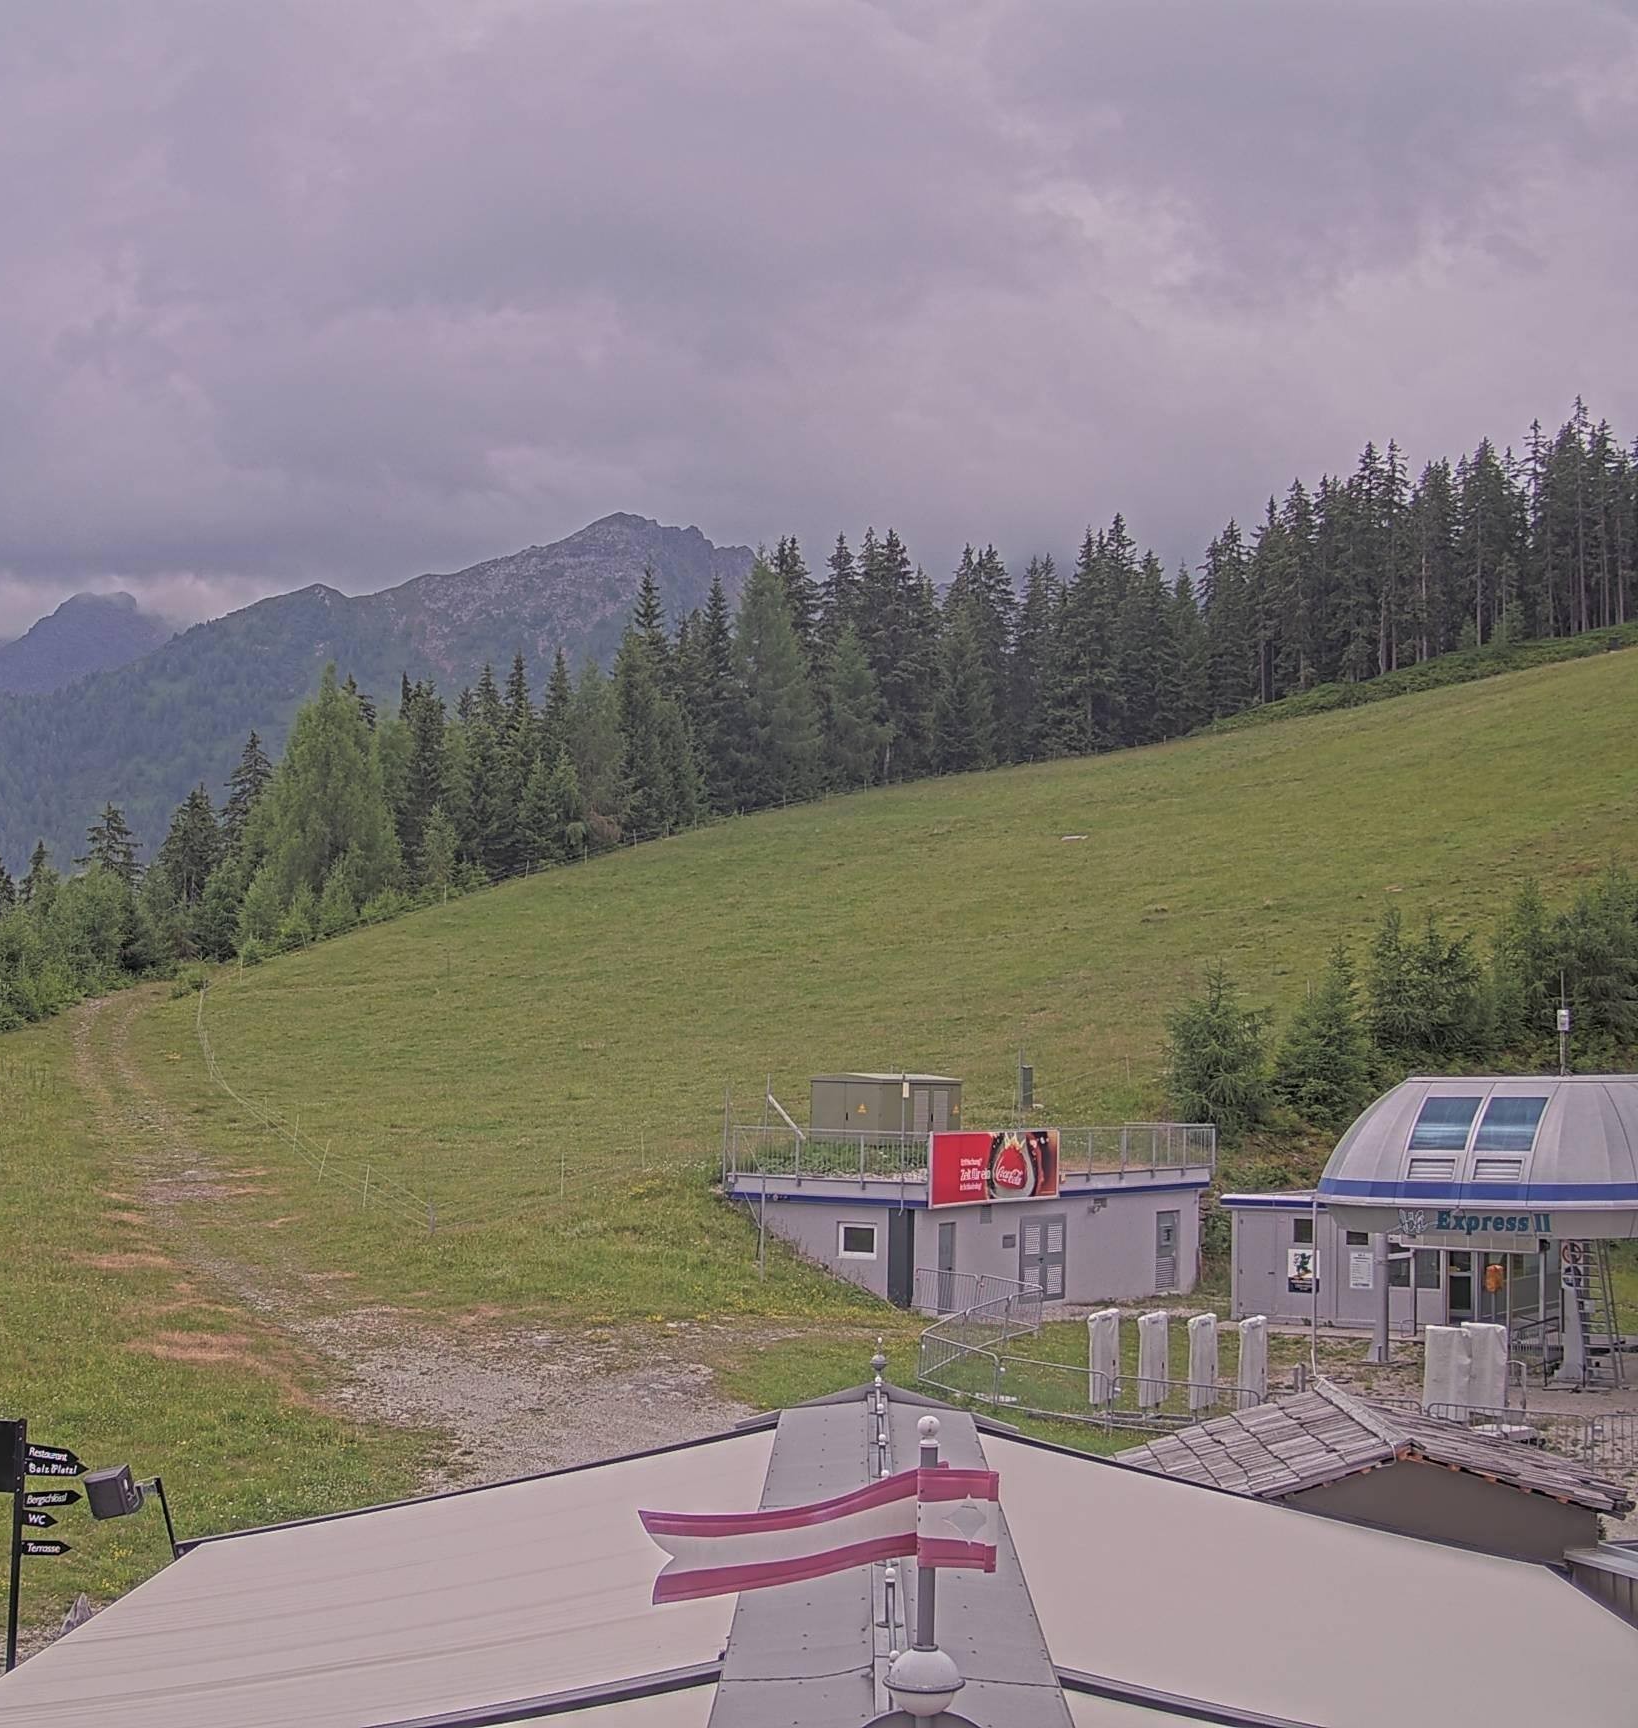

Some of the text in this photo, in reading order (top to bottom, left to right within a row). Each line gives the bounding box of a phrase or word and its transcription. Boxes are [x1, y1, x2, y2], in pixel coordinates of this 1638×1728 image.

[1437, 1211, 1529, 1235] Express
[1533, 1213, 1552, 1232] II
[28, 1513, 46, 1525] WC
[27, 1542, 61, 1553] Terrasse
